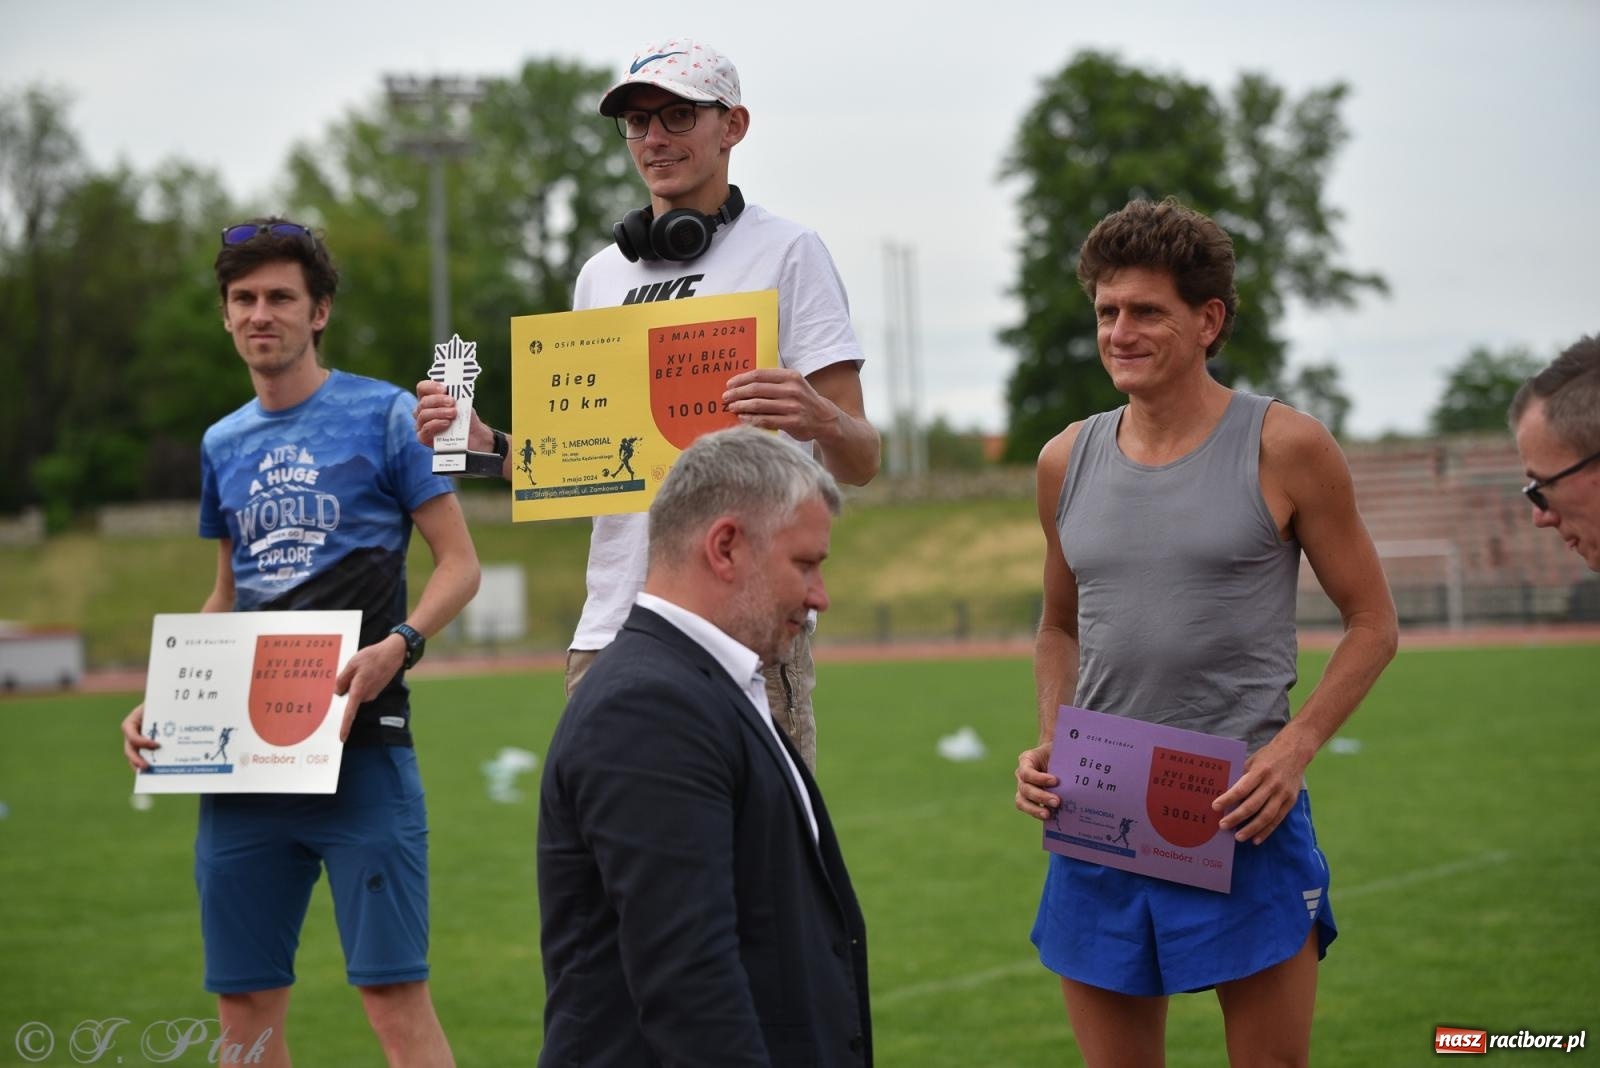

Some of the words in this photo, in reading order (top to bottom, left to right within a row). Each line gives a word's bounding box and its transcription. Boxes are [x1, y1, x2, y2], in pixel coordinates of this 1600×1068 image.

[622, 274, 705, 305] NIKE
[658, 334, 664, 343] 3
[671, 330, 705, 341] MAJA
[712, 326, 745, 337] 2024
[667, 353, 692, 365] XVI
[701, 347, 737, 361] BIEG
[655, 367, 682, 379] BEZ
[691, 359, 750, 375] GRANIC
[551, 373, 596, 387] Bieg
[549, 398, 569, 412] 10
[581, 396, 607, 409] km
[562, 441, 568, 449] 1.
[267, 467, 319, 486] HUGE
[235, 494, 341, 546] WORLD
[257, 546, 315, 571] EXPLORE
[273, 640, 300, 648] MAJA
[306, 640, 333, 648] 2024
[266, 658, 287, 668] XVI
[293, 658, 324, 668] BIEG
[179, 667, 213, 680] Bieg
[255, 670, 277, 679] BEZ
[284, 670, 332, 678] GRANIC
[175, 688, 190, 700] 10
[198, 688, 218, 700] km
[1080, 757, 1111, 774] Bieg
[1170, 755, 1194, 765] MAJA
[1074, 775, 1089, 786] 10
[1097, 779, 1117, 792] km
[1153, 776, 1174, 787] BEZ
[1163, 769, 1183, 778] XVI
[1189, 774, 1214, 786] BIEG
[1153, 847, 1193, 863] Racibórz
